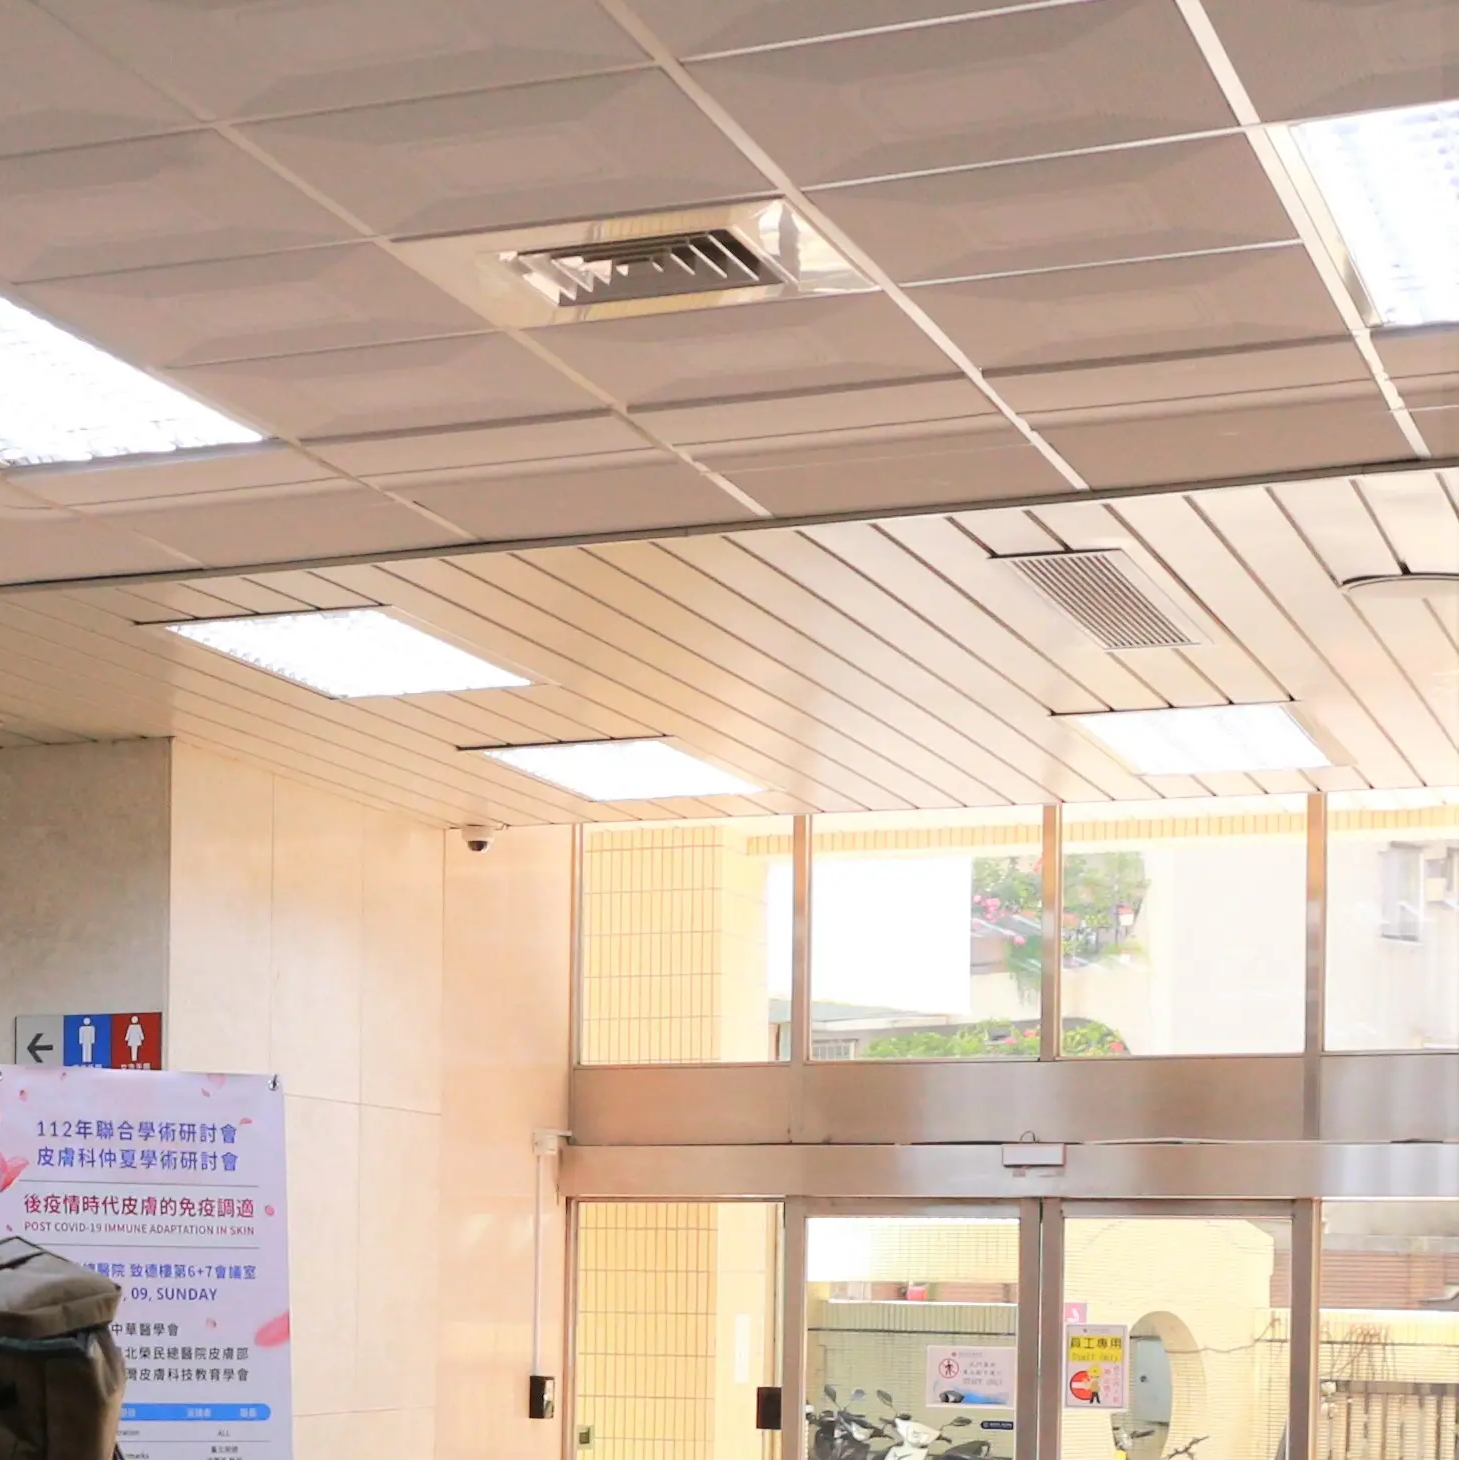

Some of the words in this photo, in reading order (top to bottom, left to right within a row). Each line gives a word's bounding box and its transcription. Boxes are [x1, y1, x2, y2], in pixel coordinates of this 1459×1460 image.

[37, 1120, 238, 1145] 112年聯合學術研討會
[37, 1147, 239, 1172] 皮膚科仲夏學術研討會
[24, 1194, 254, 1219] 後疫情時代皮膚的免疫調適
[24, 1222, 51, 1232] POST
[54, 1222, 102, 1233] COVID-19
[104, 1224, 148, 1234] IMMUNE
[149, 1224, 214, 1235] ADAPTATION
[216, 1225, 227, 1235] IN
[231, 1226, 255, 1236] SKIN
[157, 1287, 218, 1301] SUNDAY
[111, 1323, 179, 1337] 中華醫學會
